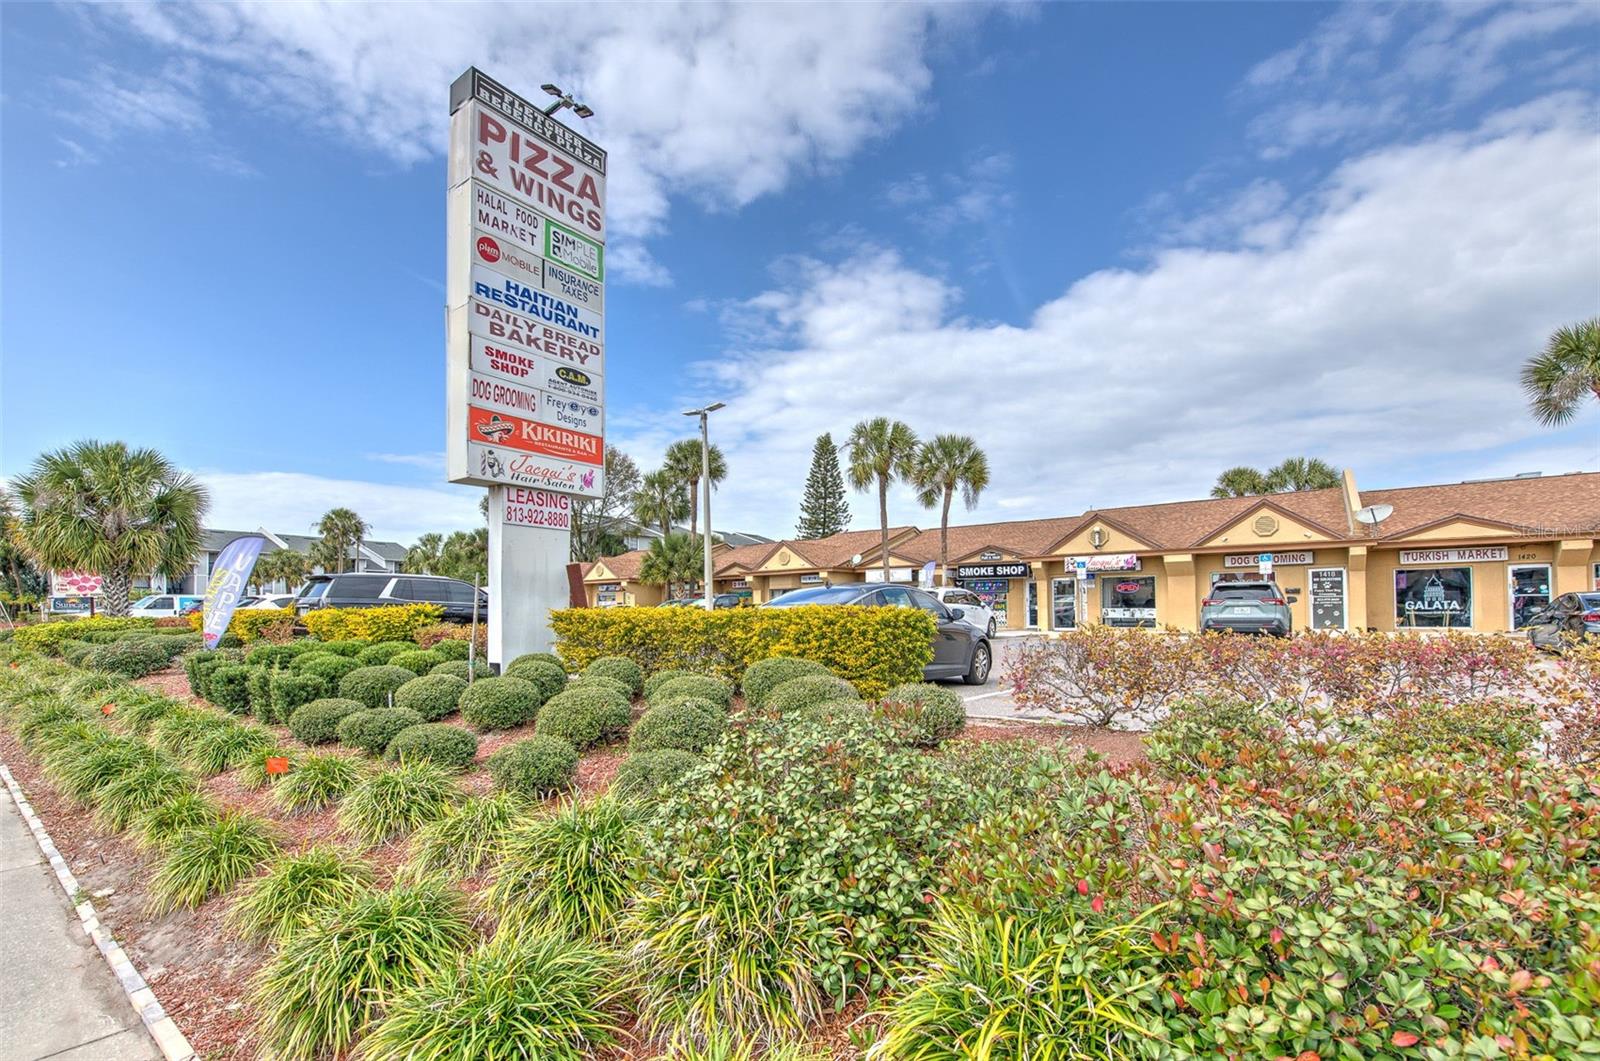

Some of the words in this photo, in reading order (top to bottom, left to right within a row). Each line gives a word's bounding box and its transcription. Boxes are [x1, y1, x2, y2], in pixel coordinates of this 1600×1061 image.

[480, 87, 552, 138] REGENCY
[557, 135, 601, 168] PLAZA
[503, 92, 583, 149] FLETCHER
[479, 110, 601, 208] PIZZA
[476, 150, 499, 180] &
[509, 165, 601, 232] WINGS
[477, 189, 508, 216] HALAL
[516, 208, 539, 229] FOOD
[478, 209, 537, 246] MARKET
[552, 230, 596, 261] SIMPLE
[501, 252, 540, 276] MOBILE
[563, 248, 597, 274] Mobile
[549, 266, 599, 297] INSURANCE
[561, 283, 588, 302] TAXES
[475, 281, 600, 338] RESTAURANT
[506, 280, 578, 319] HAITIAN
[475, 303, 536, 333] DAILY
[543, 327, 600, 356] BREAD
[489, 321, 589, 365] BAKERY
[485, 345, 534, 370] SMOKE
[491, 359, 529, 378] SHOP
[472, 378, 491, 400] DOG
[493, 384, 536, 413] GROOMING
[557, 411, 587, 429] Designs
[521, 421, 597, 454] KIKIRIKI
[510, 454, 576, 483] Jacqui's
[511, 472, 540, 484] Hair
[543, 478, 575, 490] Salon
[506, 486, 569, 510] LEASING
[506, 506, 569, 528] 813-922-8880
[1230, 556, 1250, 565] DOG
[1253, 553, 1306, 565] GOMING
[1404, 551, 1449, 562] TURKISH
[1458, 548, 1505, 560] MARKET
[959, 567, 994, 576] SMOKE
[996, 565, 1025, 575] SHOP
[1117, 584, 1138, 592] OPEN
[1405, 600, 1461, 610] GALATA
